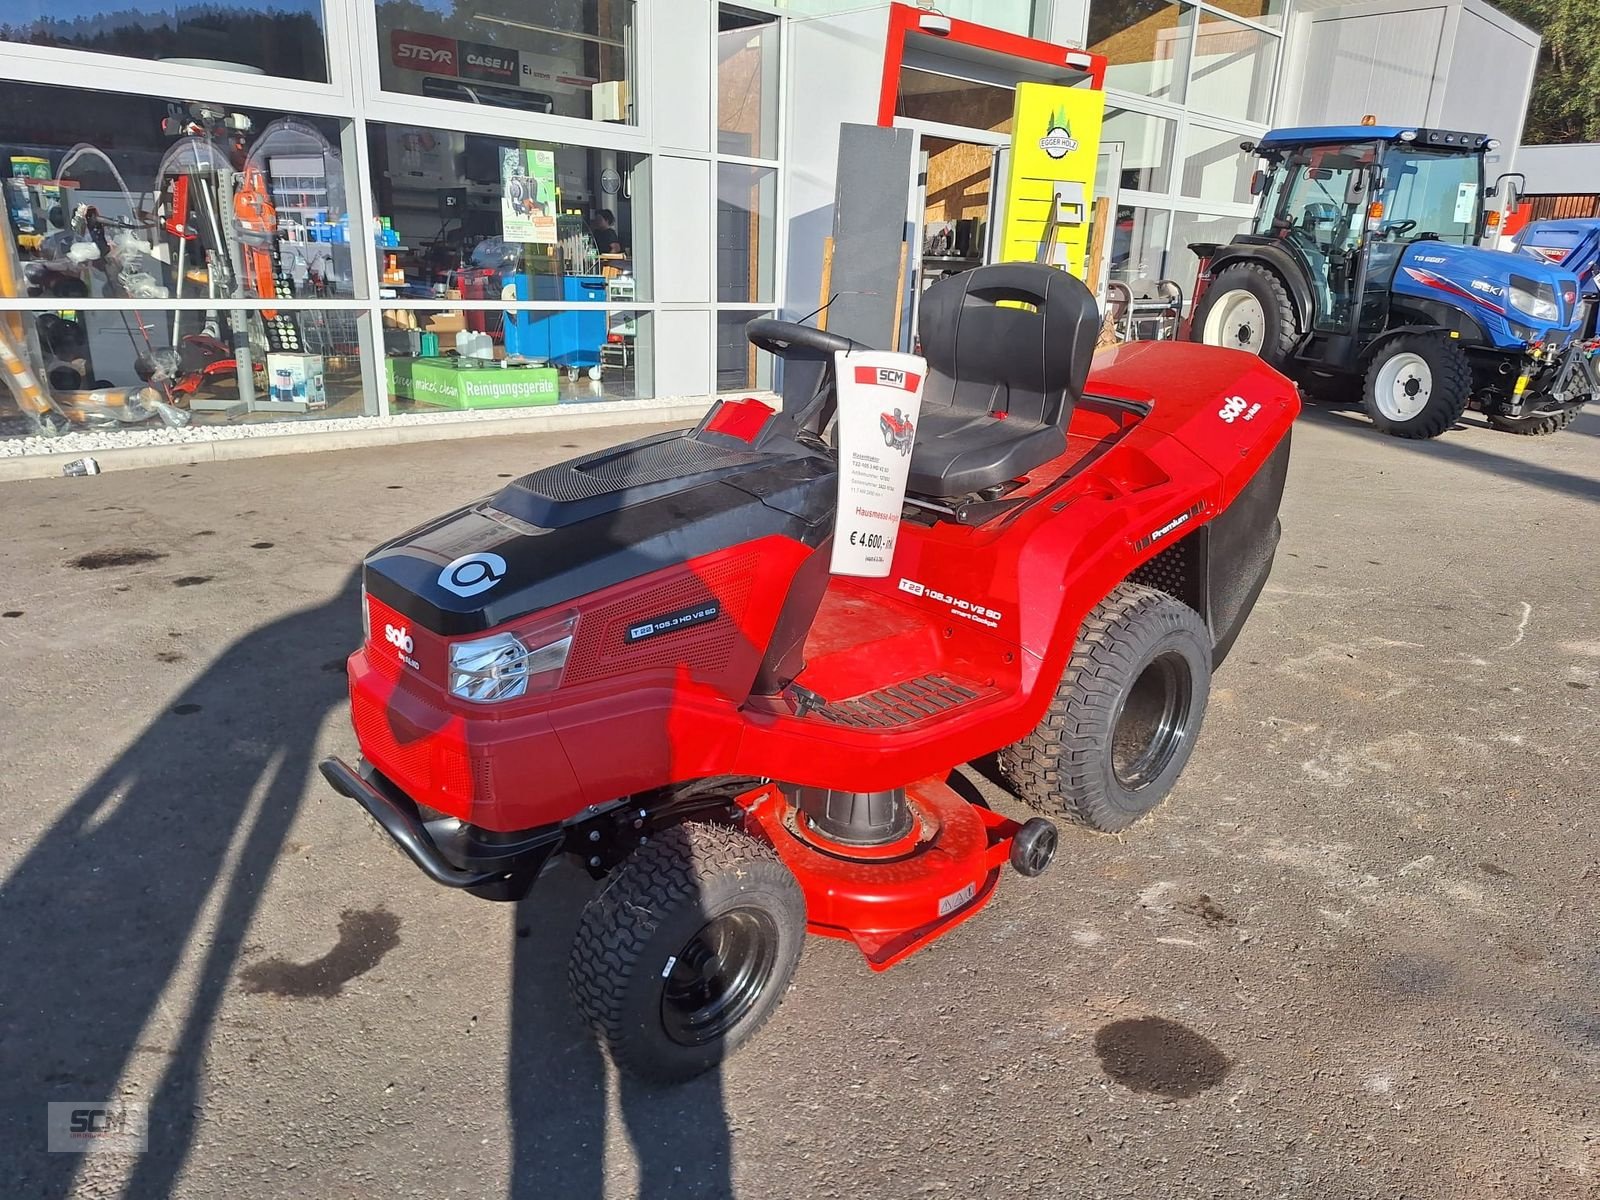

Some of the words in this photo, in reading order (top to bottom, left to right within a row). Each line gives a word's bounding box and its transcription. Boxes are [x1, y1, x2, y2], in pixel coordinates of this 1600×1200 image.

[397, 43, 453, 65] STEYR
[466, 54, 501, 69] CASE
[1041, 138, 1061, 147] EGGER
[1061, 139, 1076, 149] HOLZ
[1471, 280, 1504, 296] ISEKI
[879, 369, 904, 384] SCM
[466, 378, 554, 399] Reinigungsgeräte
[1218, 395, 1248, 423] solo
[855, 506, 889, 521] Hausmesse
[1151, 513, 1189, 541] Premium
[850, 530, 858, 546] €
[908, 583, 922, 594] 22
[924, 588, 953, 604] 105.3
[953, 598, 970, 610] HD
[970, 603, 986, 615] V2
[640, 626, 653, 635] 22
[654, 618, 679, 630] 105.3
[679, 615, 692, 624] HD
[692, 611, 705, 619] V2
[971, 614, 998, 628] Cockpit
[385, 623, 414, 654] solo
